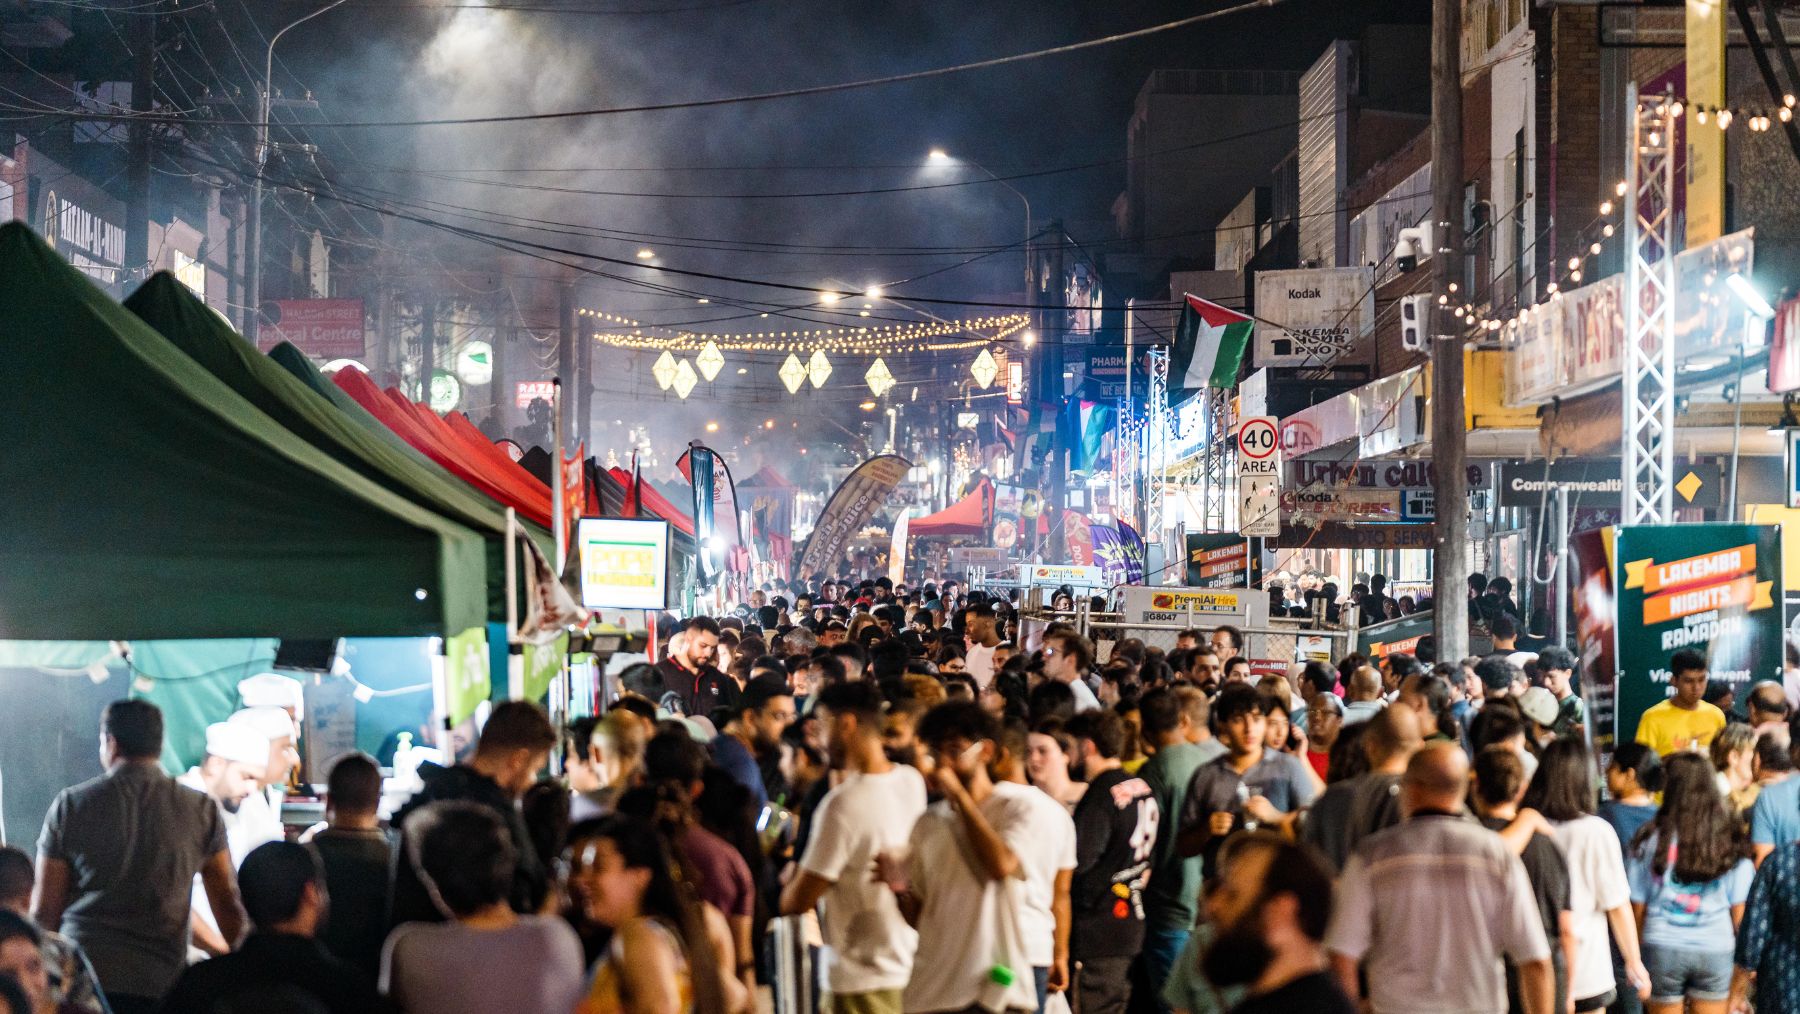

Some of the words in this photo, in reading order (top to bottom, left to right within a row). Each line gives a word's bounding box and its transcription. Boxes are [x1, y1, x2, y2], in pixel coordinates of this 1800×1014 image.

[1289, 288, 1321, 299] Kodak
[312, 327, 361, 341] Centre
[1092, 358, 1142, 366] PHARMAY
[1243, 429, 1274, 448] 40
[1241, 461, 1278, 472] AREA
[1384, 460, 1483, 487] culte
[1512, 478, 1623, 492] Commnwealth
[838, 495, 869, 533] Juice
[1212, 560, 1239, 574] NIGHTS
[1659, 551, 1741, 585] LAKEMBA
[1174, 594, 1217, 605] PremiAir
[1669, 585, 1732, 616] NIGHTS
[1149, 613, 1177, 621] G8047
[1386, 639, 1417, 654] LAKEM
